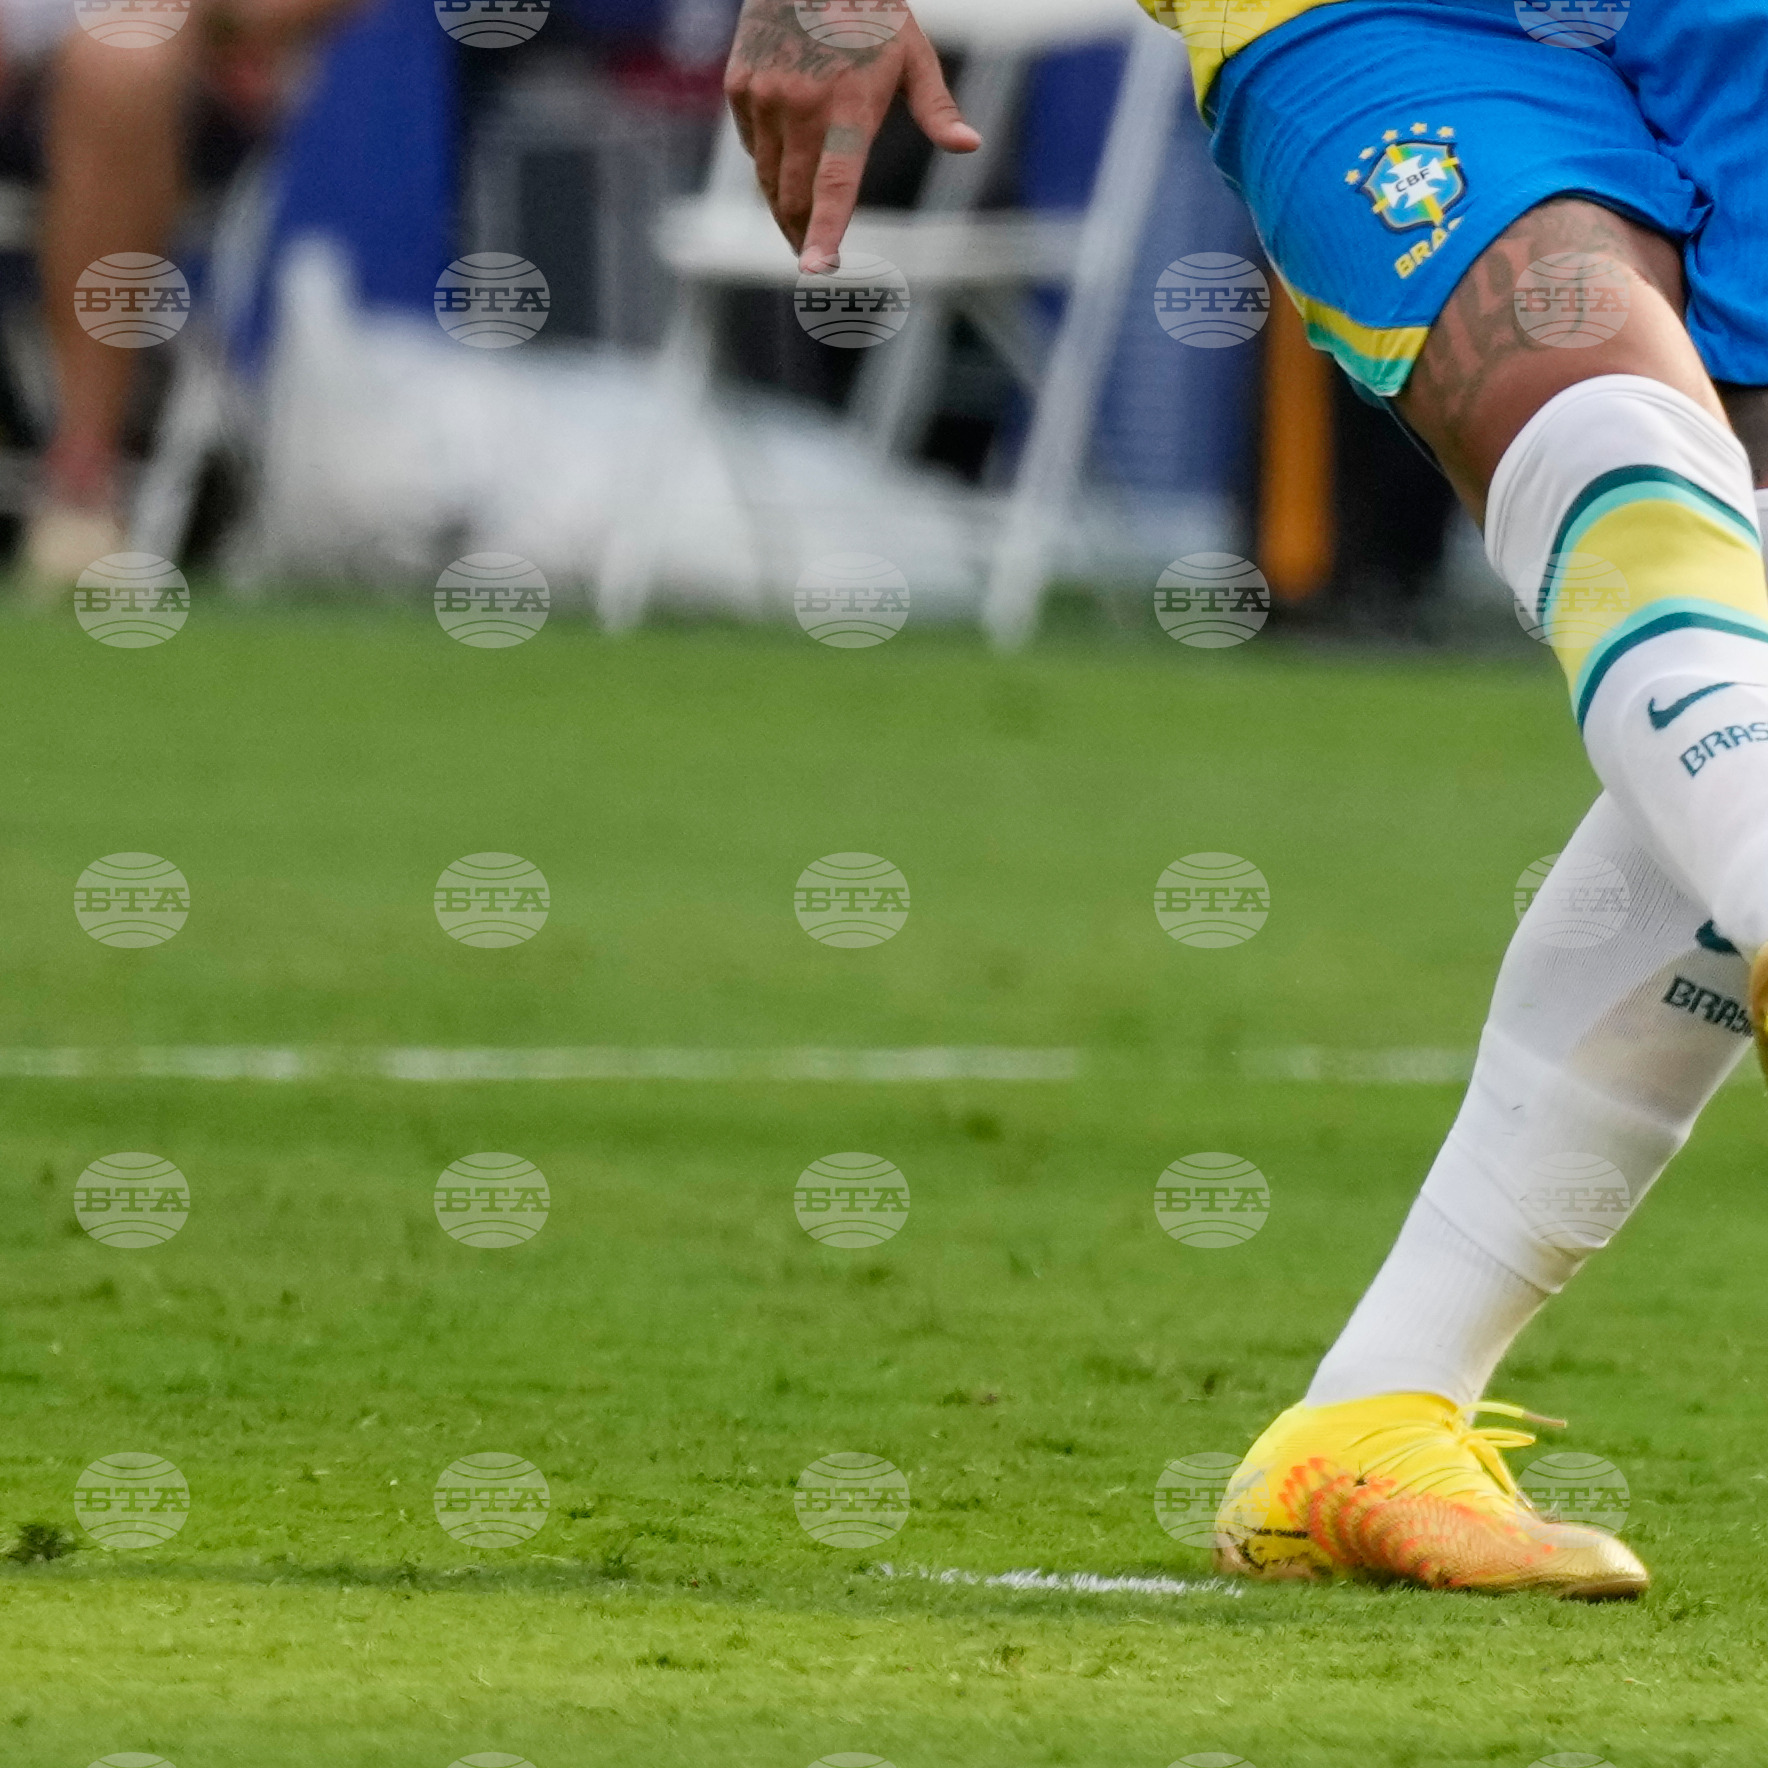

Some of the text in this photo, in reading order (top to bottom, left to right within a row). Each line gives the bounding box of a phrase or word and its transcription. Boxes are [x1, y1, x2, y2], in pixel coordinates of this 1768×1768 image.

[1394, 167, 1431, 194] CBF
[1393, 216, 1464, 279] BRA
[1661, 974, 1754, 1038] BRAS
